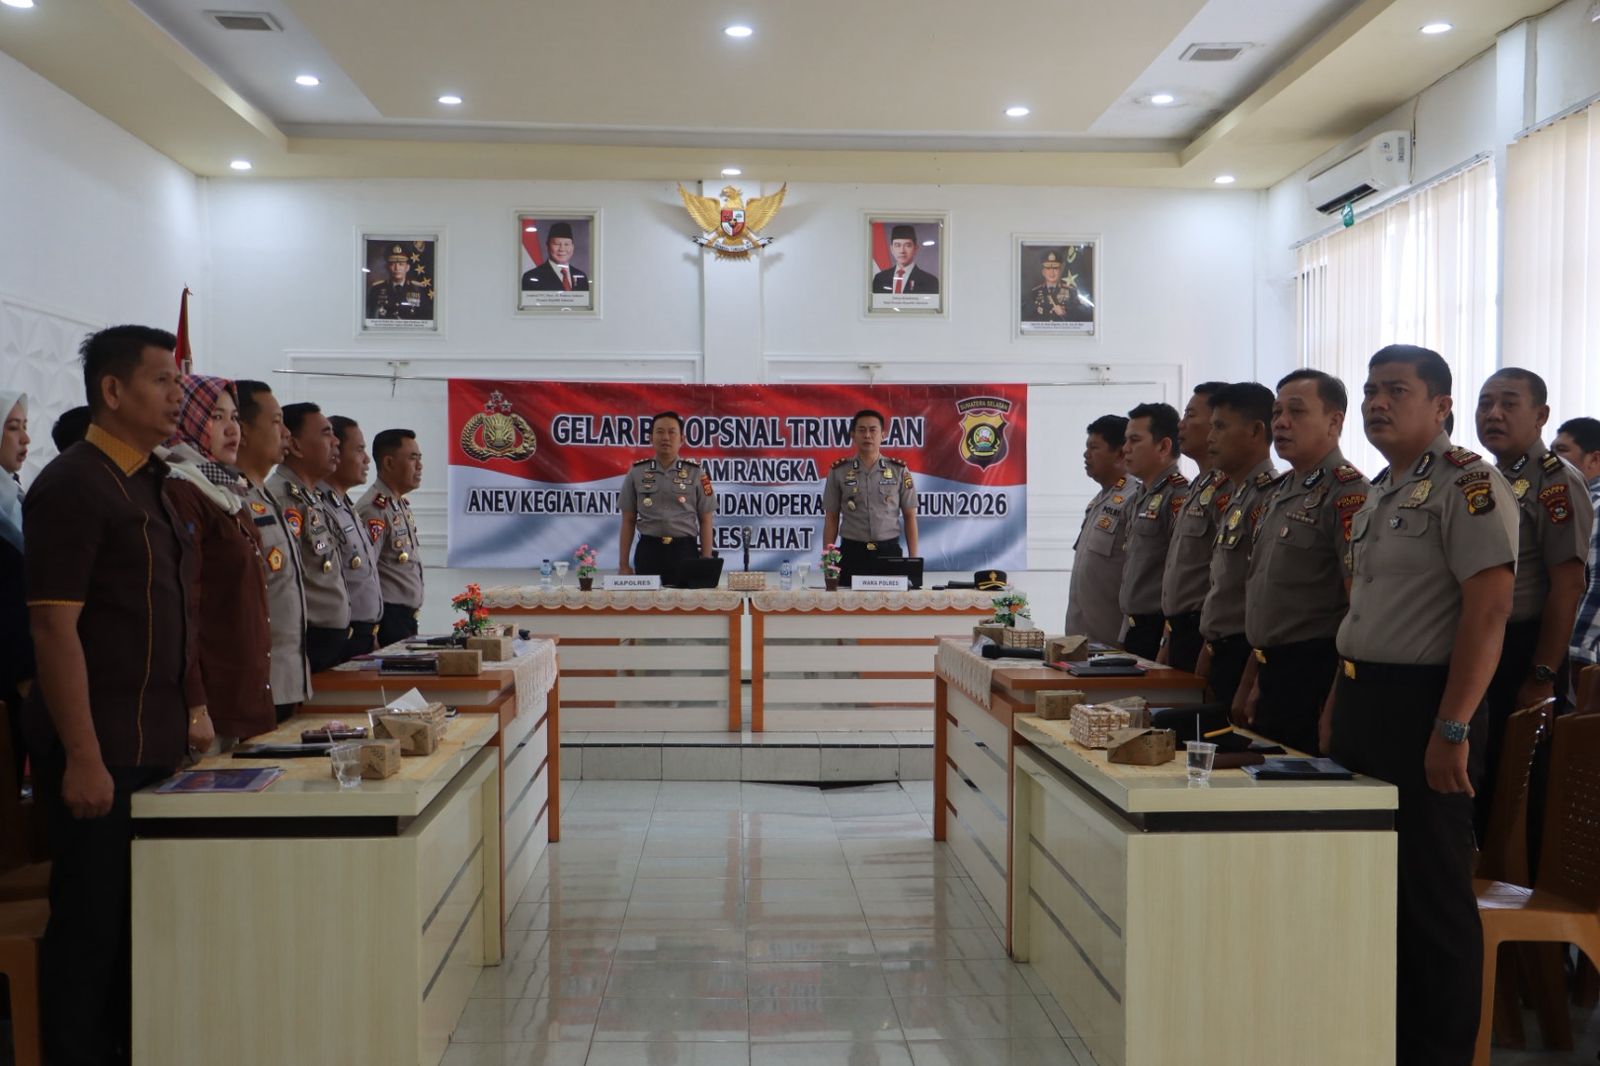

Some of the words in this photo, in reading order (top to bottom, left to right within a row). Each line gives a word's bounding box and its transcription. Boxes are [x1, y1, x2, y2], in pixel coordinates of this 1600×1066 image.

[552, 414, 635, 447] GELAR
[685, 416, 784, 448] OPSNAL
[733, 458, 819, 483] RANGKA
[468, 489, 518, 513] ANEV
[520, 489, 613, 514] KEGIATAN
[724, 492, 762, 516] DAN
[917, 492, 958, 517] HUN
[959, 493, 1008, 517] 2026
